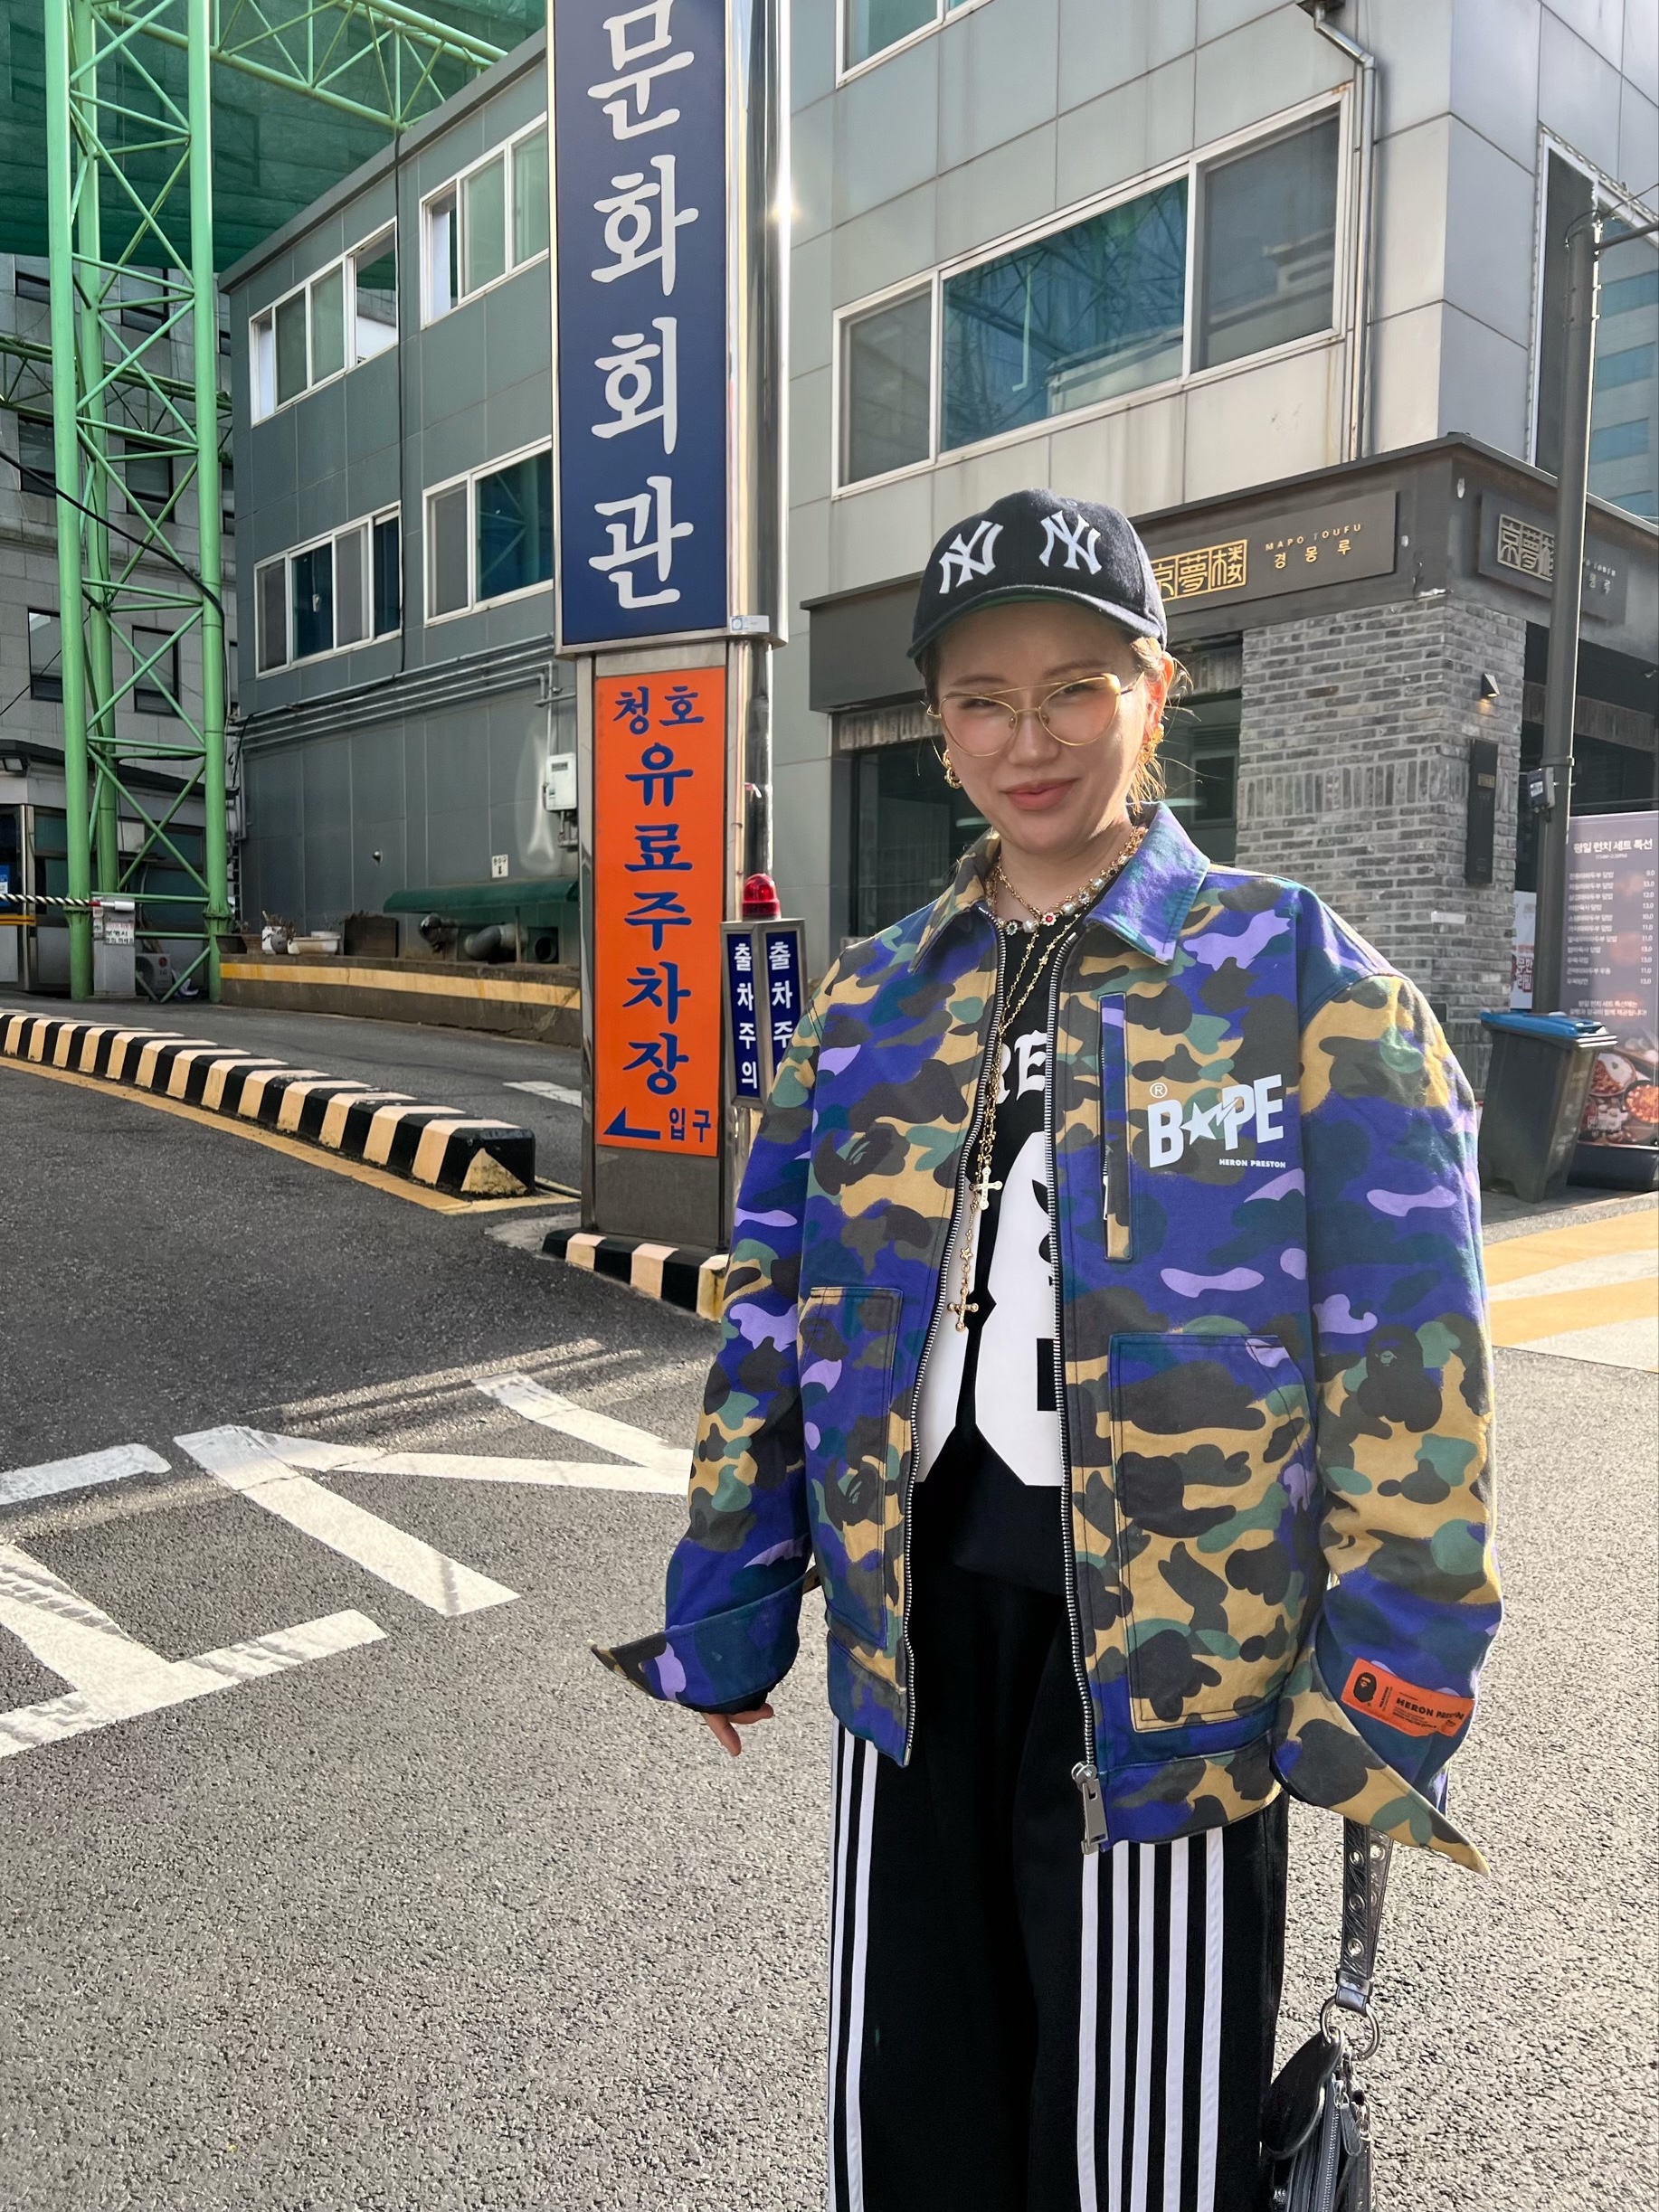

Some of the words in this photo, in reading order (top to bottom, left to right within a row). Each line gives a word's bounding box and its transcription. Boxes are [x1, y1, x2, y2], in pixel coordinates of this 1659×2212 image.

[588, 0, 698, 610] 문화회관
[1266, 535, 1304, 552] MAPO
[1313, 523, 1362, 541] TOUFU
[1274, 539, 1351, 570] 경몽루
[612, 685, 704, 735] 청호
[1593, 841, 1612, 853] 런치
[1613, 839, 1632, 852] 세트
[1633, 837, 1654, 850] 특선
[622, 742, 694, 1095] 유료주차장
[734, 942, 758, 1090] 출차주의
[769, 941, 793, 1072] 출차주
[668, 1107, 712, 1143] 입구
[1218, 1158, 1248, 1167] HERON
[1250, 1159, 1286, 1168] PRESTON
[1396, 1697, 1434, 1716] HERON
